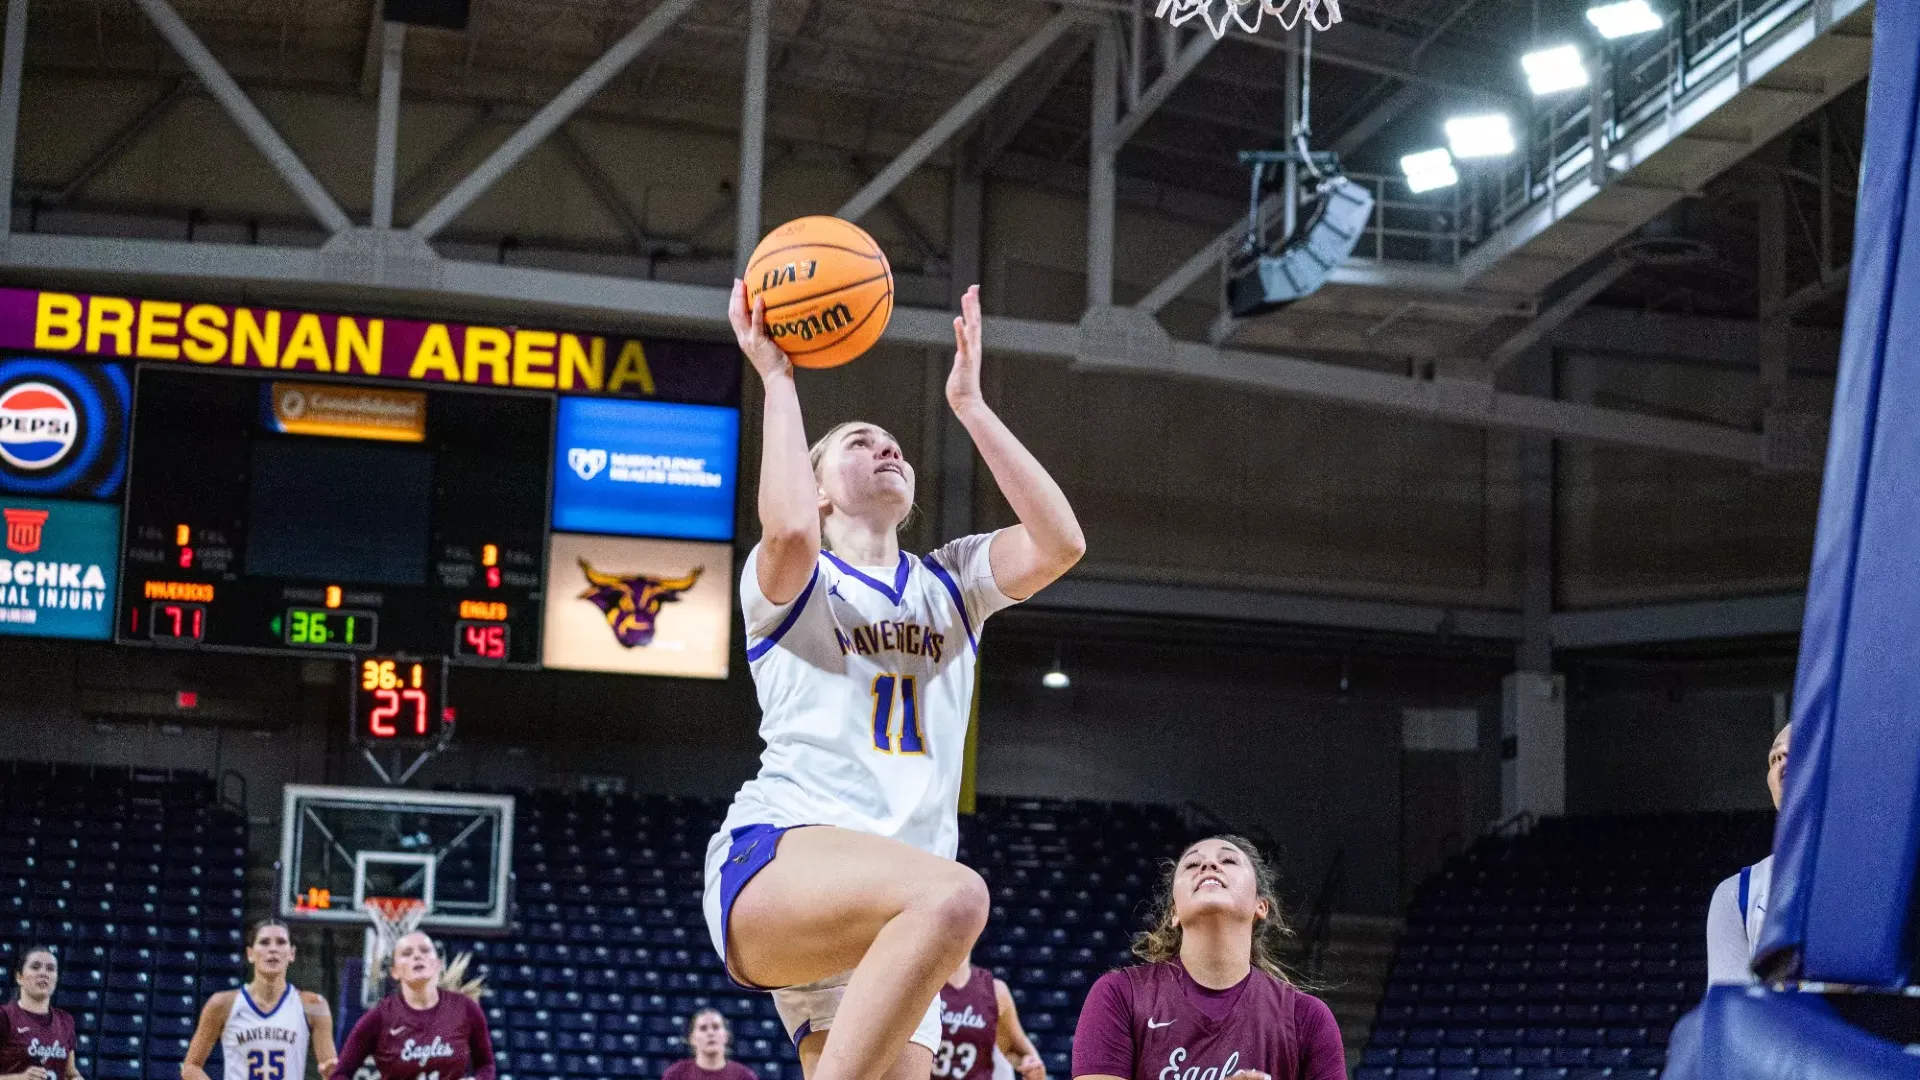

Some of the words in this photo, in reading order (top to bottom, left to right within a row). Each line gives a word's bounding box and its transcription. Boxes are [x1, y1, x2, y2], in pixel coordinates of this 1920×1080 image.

[764, 302, 854, 341] Wilson
[35, 291, 384, 375] BRESNAN
[408, 323, 656, 394] ARENA
[0, 416, 69, 434] PEPSI
[38, 587, 105, 611] INJURY
[165, 606, 202, 639] 71
[466, 625, 506, 659] 45
[362, 659, 422, 690] 36.1
[370, 689, 427, 736] 27
[871, 672, 927, 755] 11
[236, 1027, 297, 1045] MAVERICKS
[401, 1036, 454, 1067] Eagles
[248, 1050, 286, 1080] 25
[932, 1040, 978, 1079] 33
[1159, 1047, 1271, 1080] Eal
